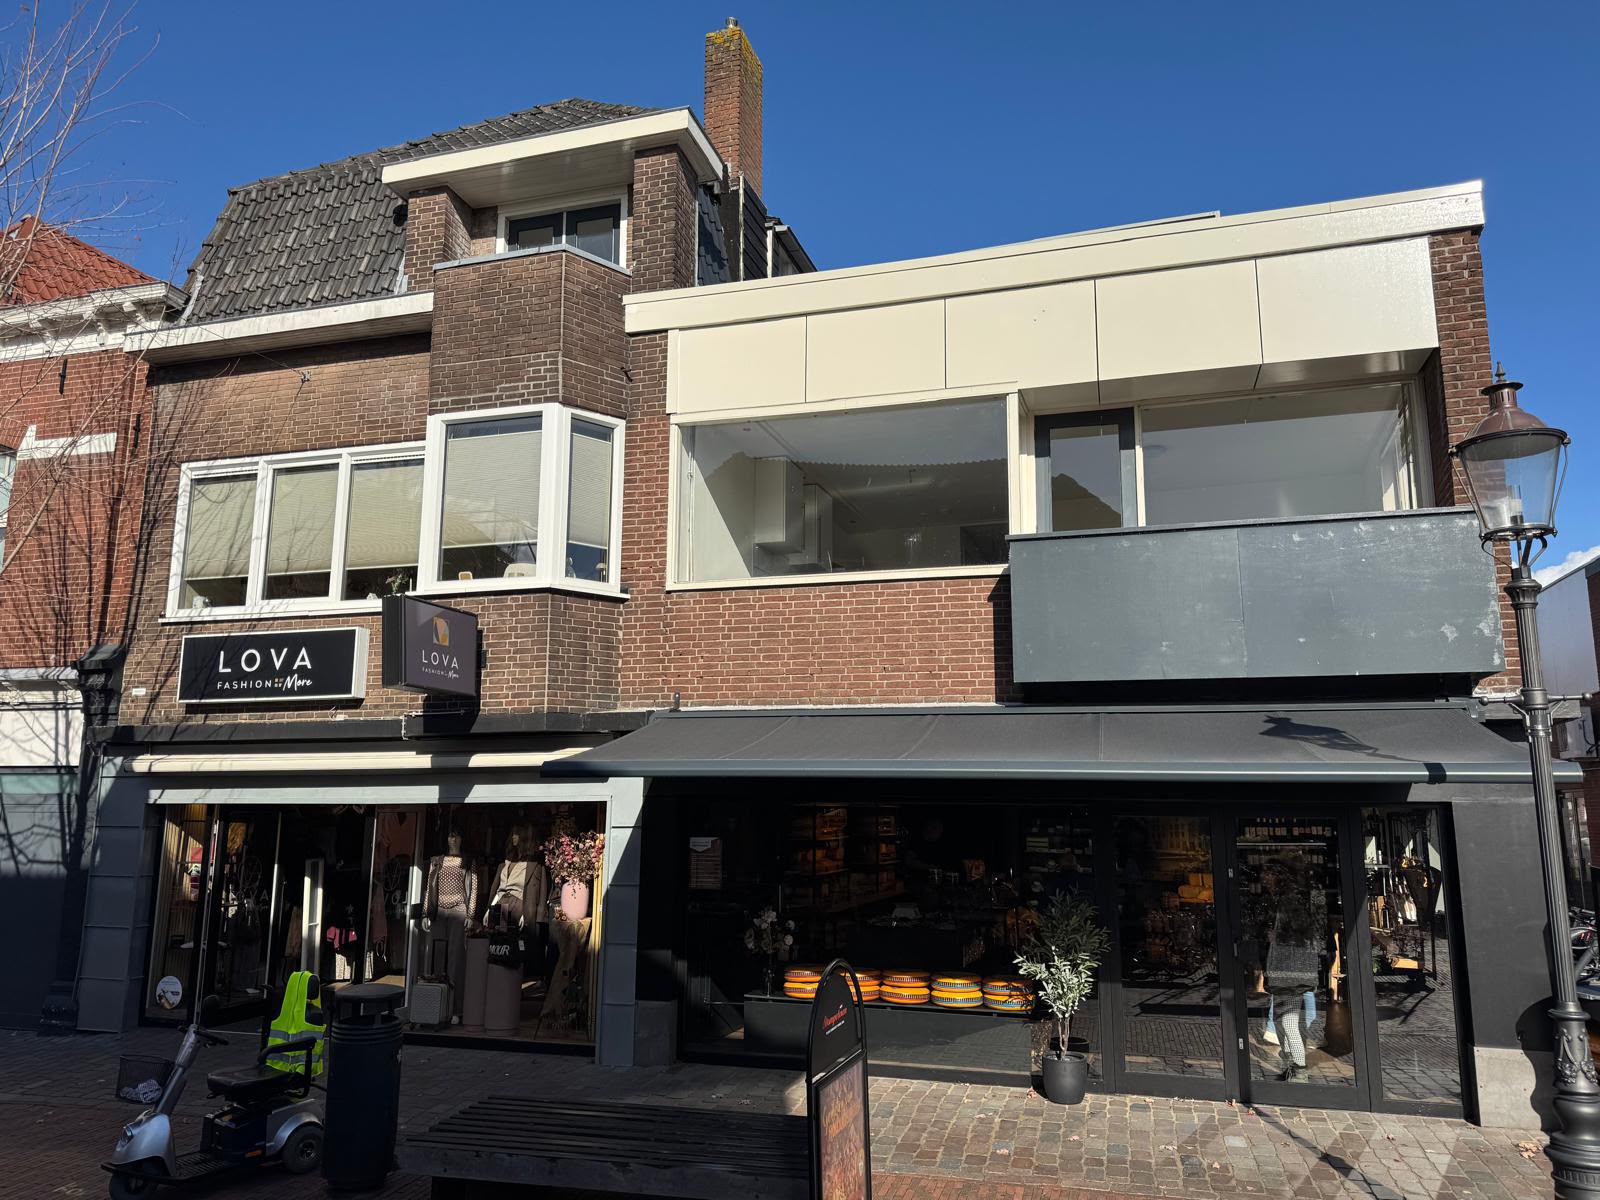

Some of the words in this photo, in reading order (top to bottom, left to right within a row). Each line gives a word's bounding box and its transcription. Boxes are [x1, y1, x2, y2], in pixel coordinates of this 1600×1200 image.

[218, 646, 312, 673] LOVA
[422, 649, 459, 670] LOVA
[422, 666, 445, 676] FASHION
[217, 679, 272, 690] FASHION
[282, 673, 313, 691] More
